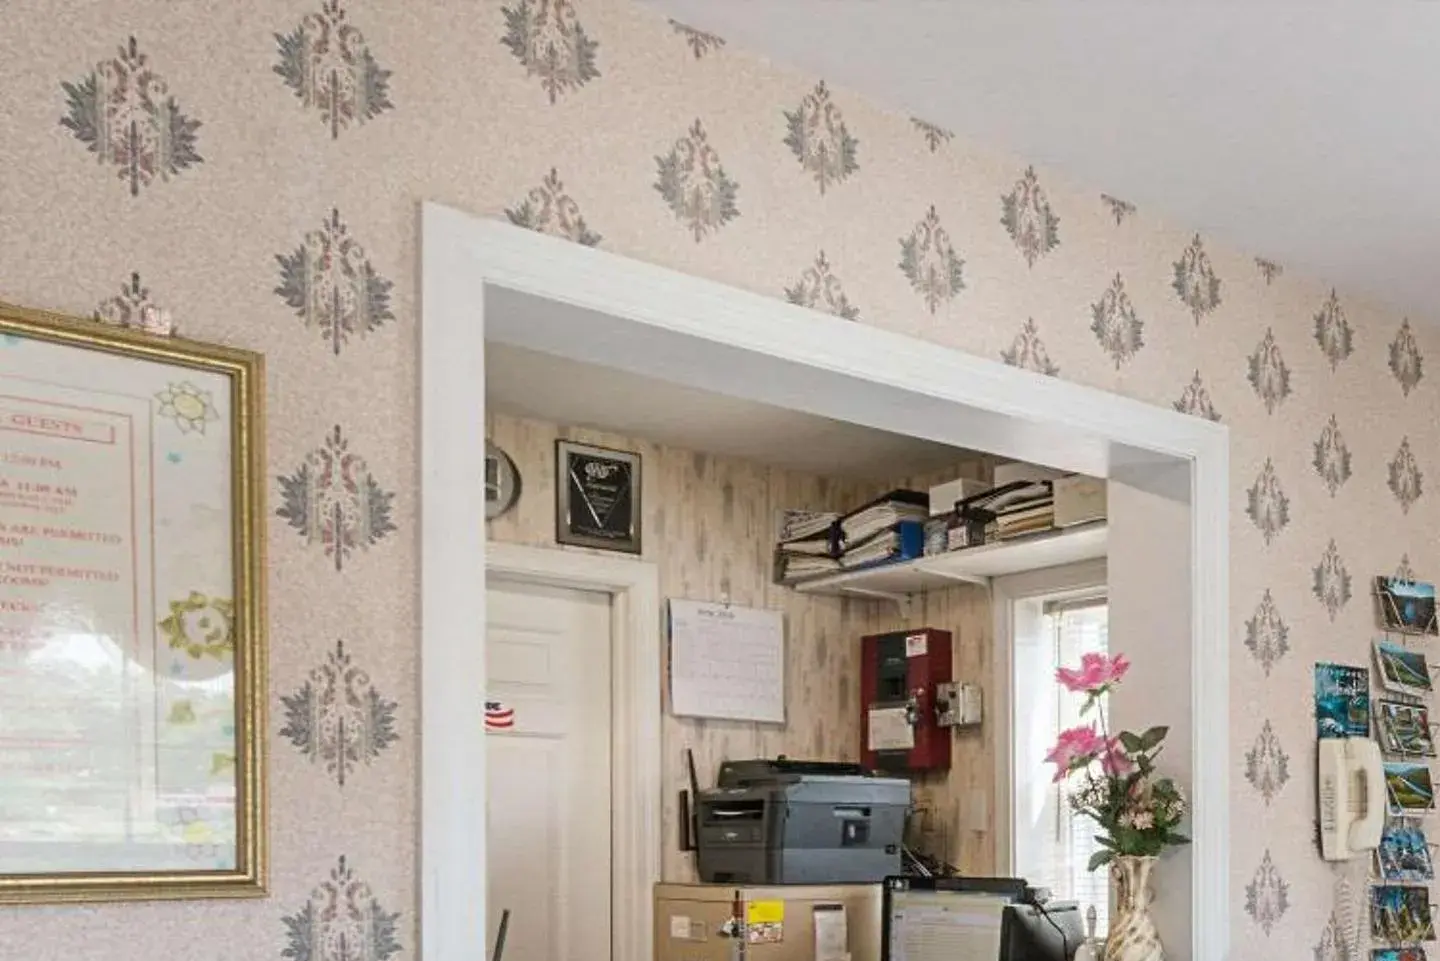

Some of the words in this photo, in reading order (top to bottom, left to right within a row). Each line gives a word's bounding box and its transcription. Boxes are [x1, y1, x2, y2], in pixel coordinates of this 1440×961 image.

[12, 414, 83, 433] GUESTS
[42, 527, 123, 545] PERMITTED
[40, 565, 120, 582] PERMITTED
